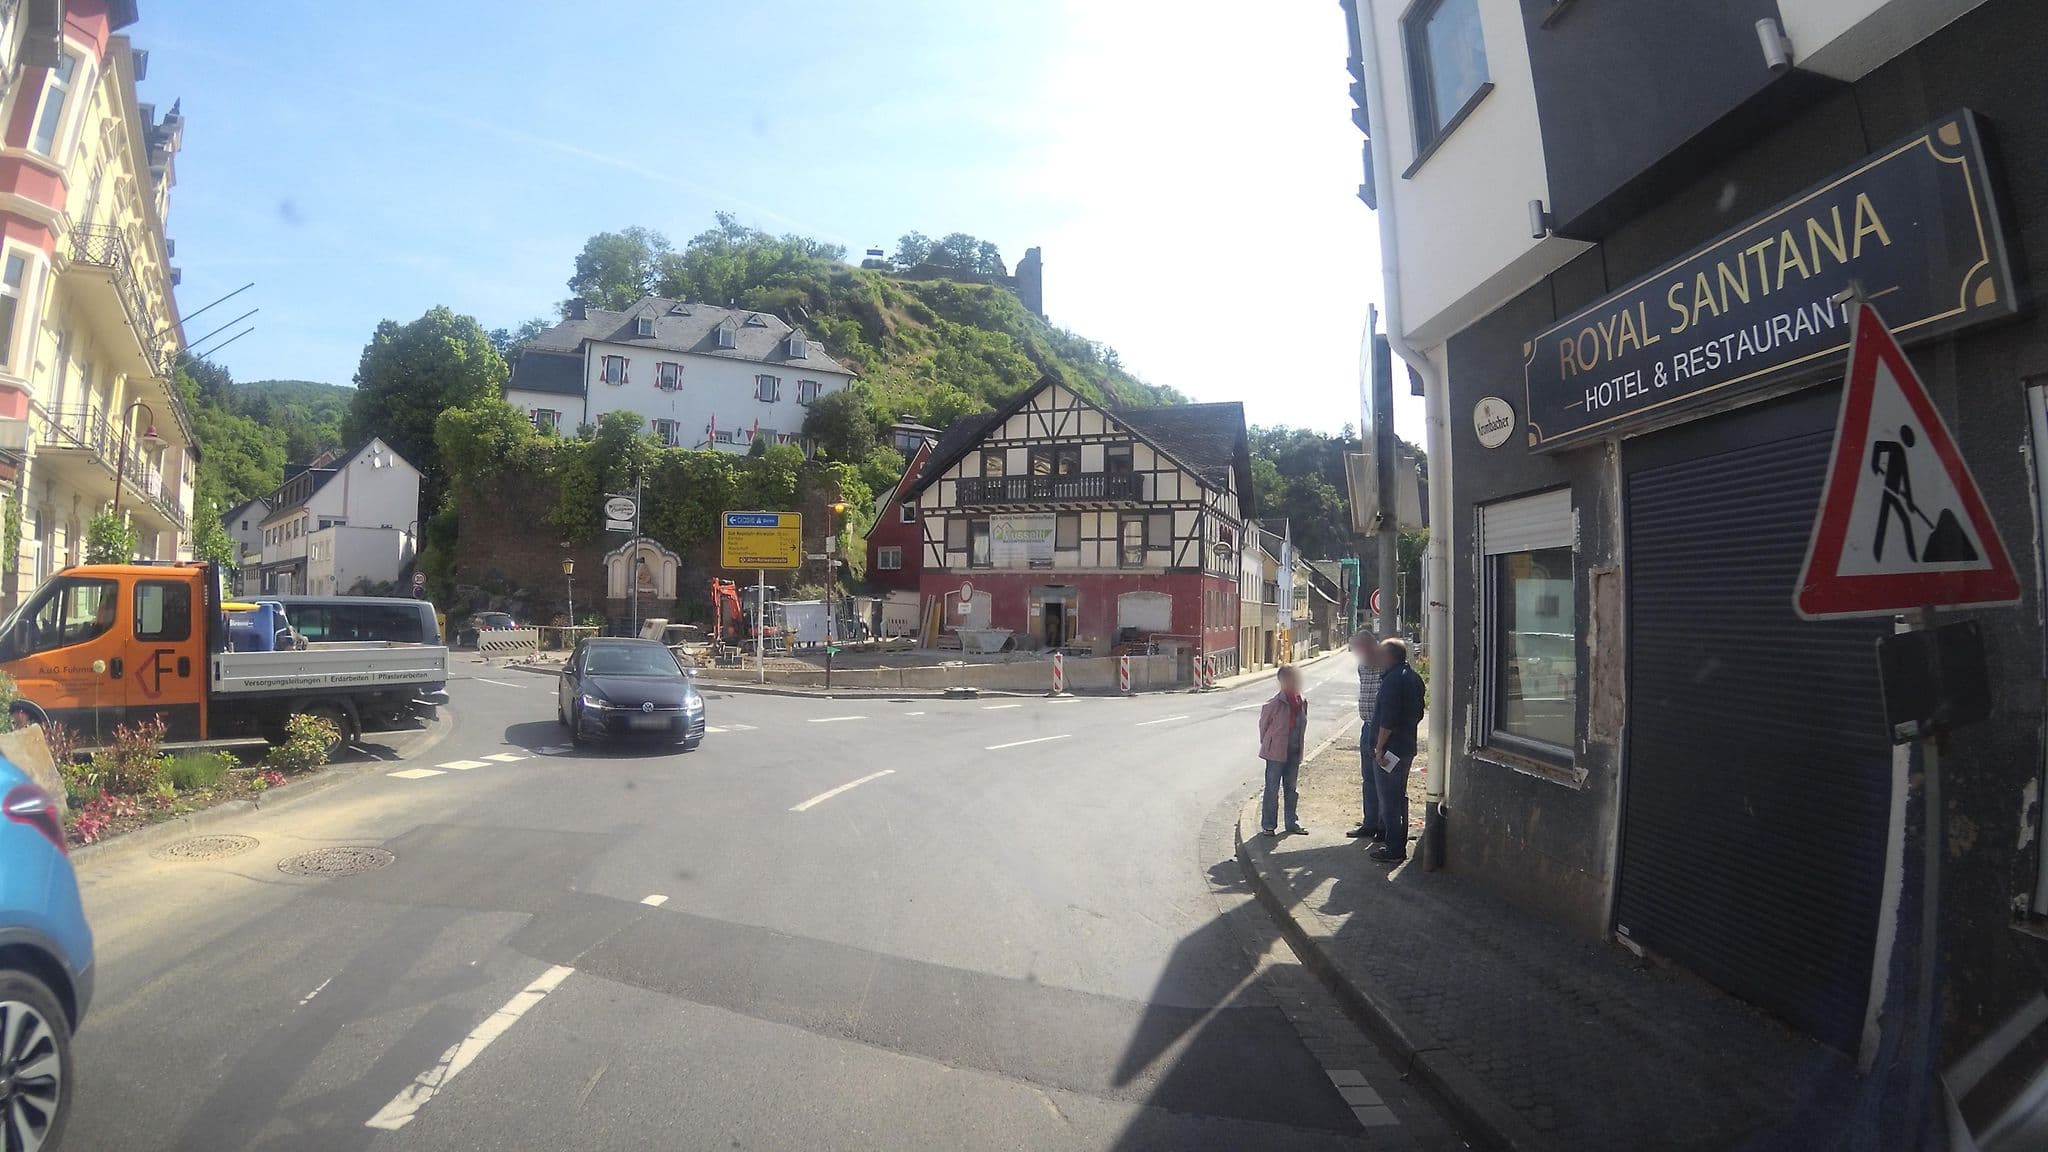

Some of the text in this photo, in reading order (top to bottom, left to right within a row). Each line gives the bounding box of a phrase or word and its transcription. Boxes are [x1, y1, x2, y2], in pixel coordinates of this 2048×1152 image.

[1559, 192, 1891, 381] ROYAL SANTANA
[1585, 292, 1849, 412] HOTEL & RESTAURANT
[1477, 416, 1509, 436] Krombacher
[244, 671, 428, 687] Versorgungsleitungen Erdarbeiten Pflasterarbeiten
